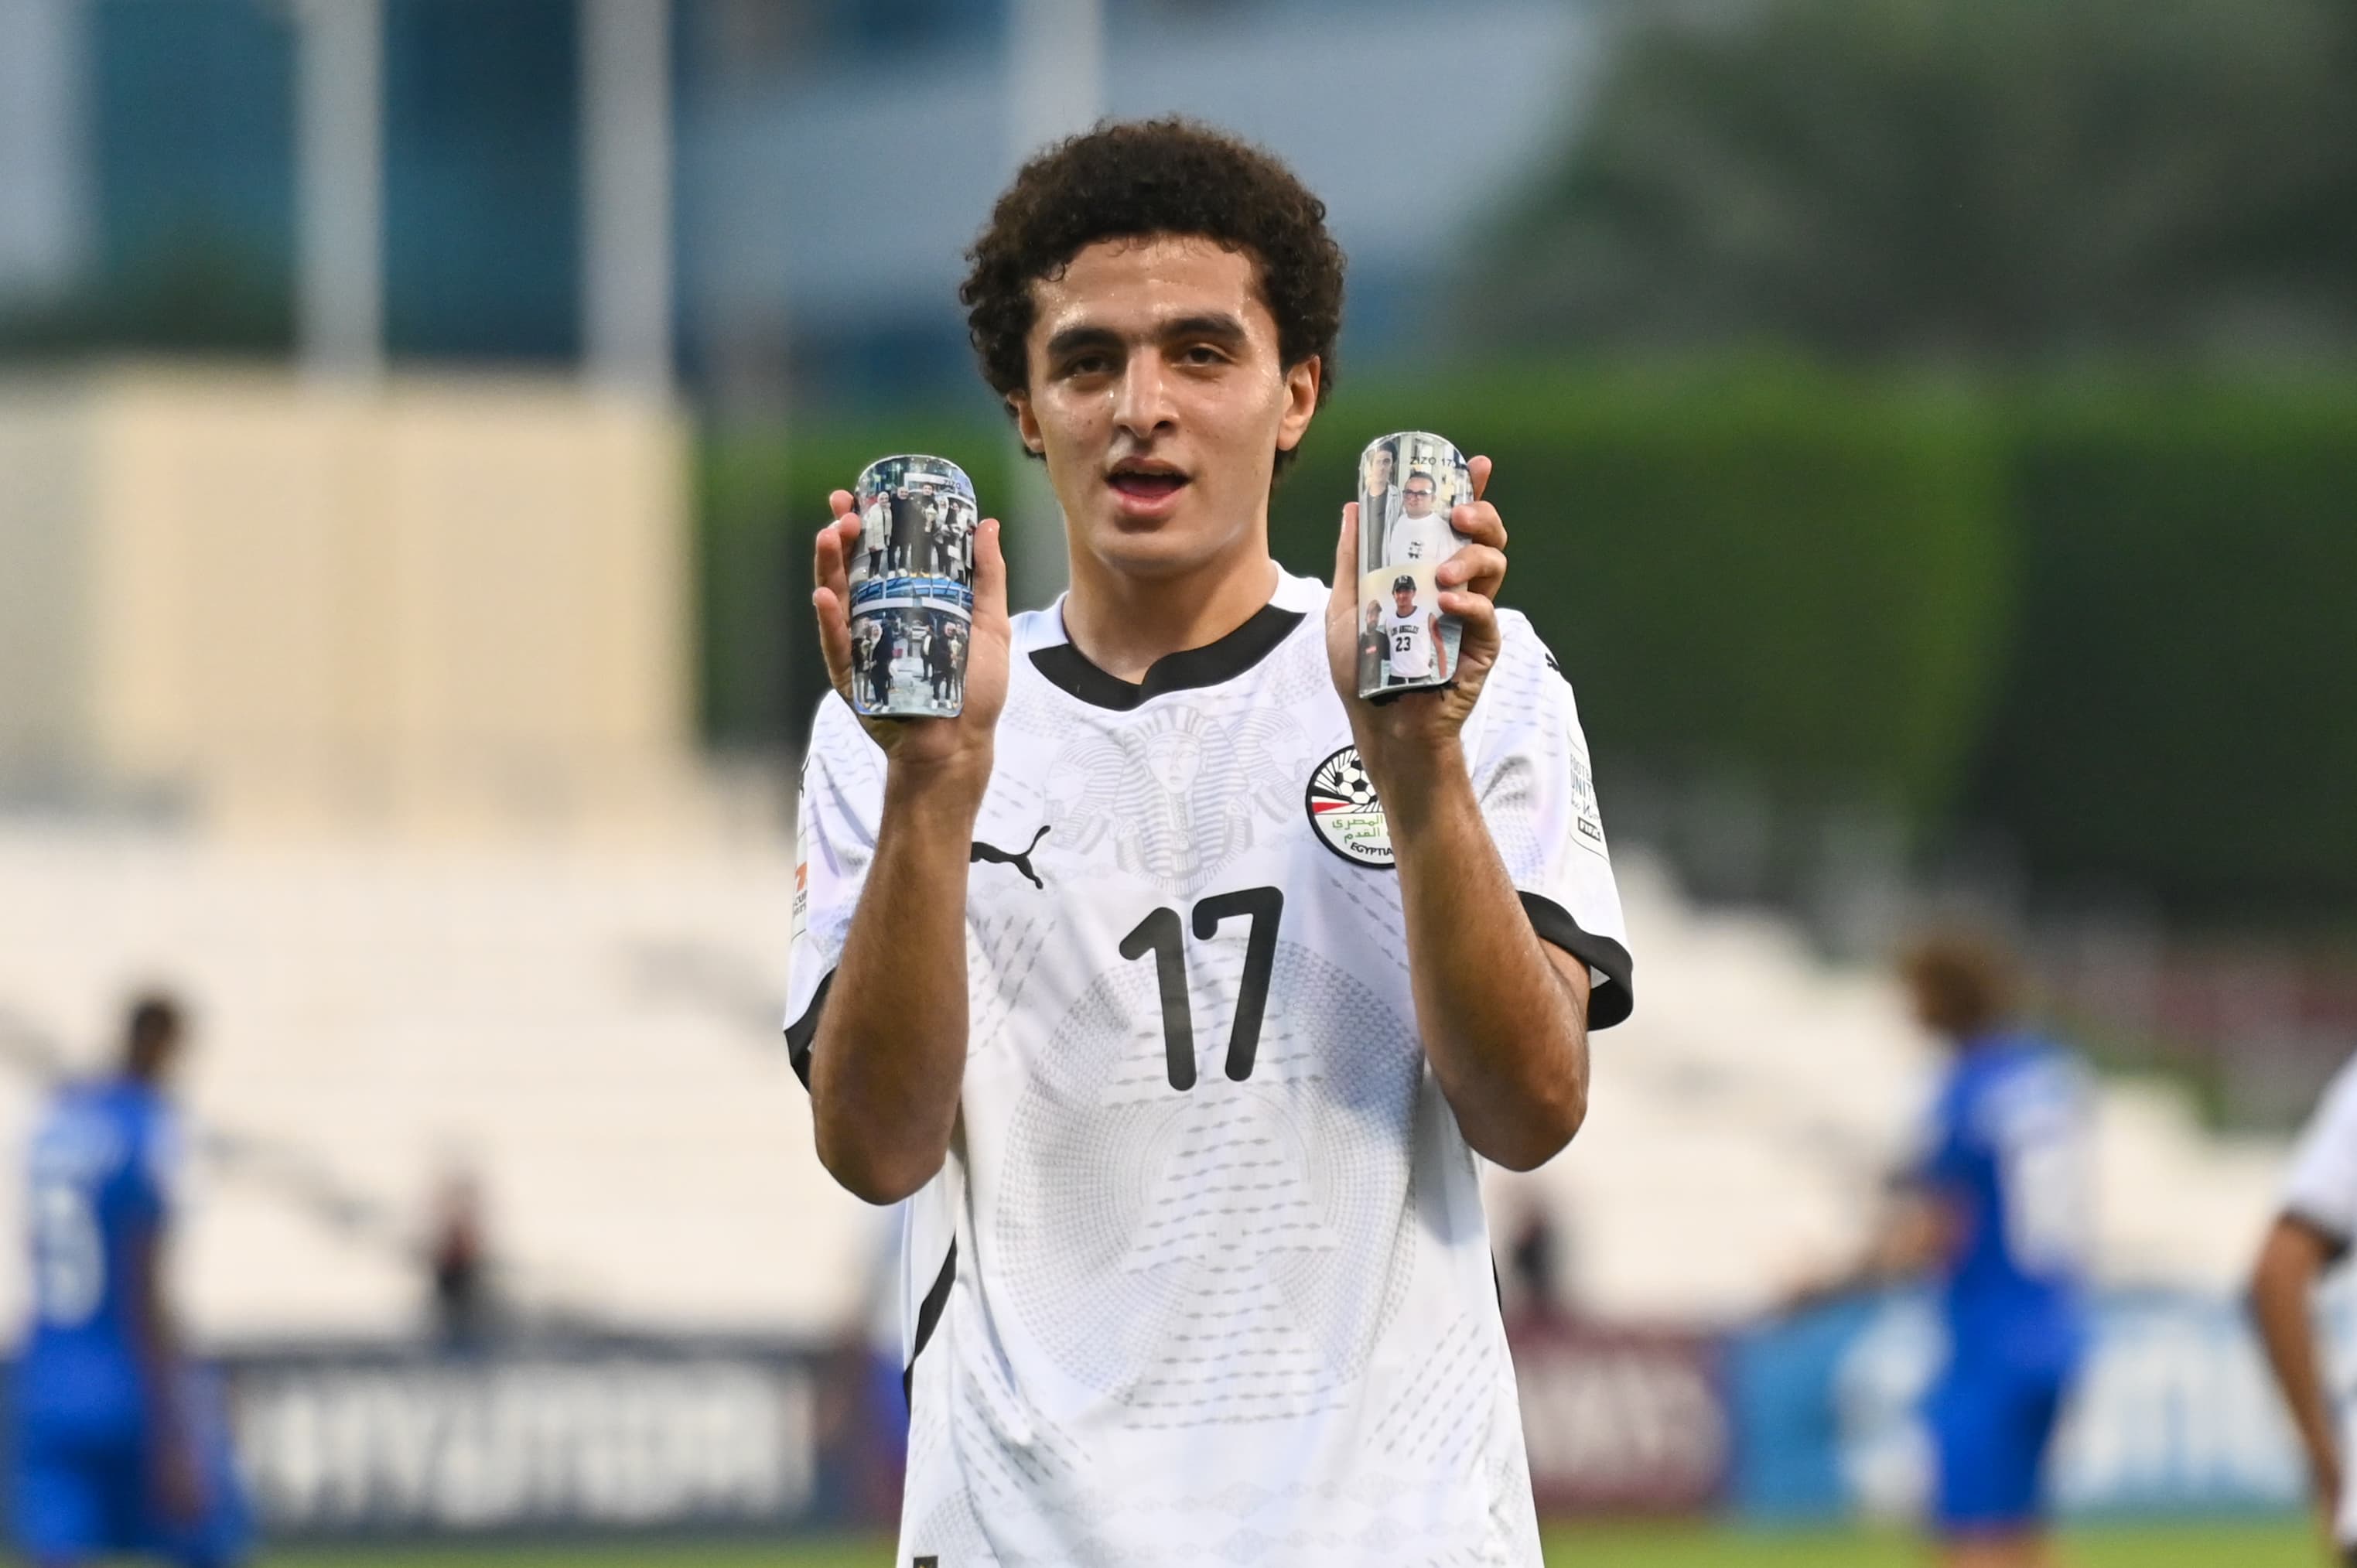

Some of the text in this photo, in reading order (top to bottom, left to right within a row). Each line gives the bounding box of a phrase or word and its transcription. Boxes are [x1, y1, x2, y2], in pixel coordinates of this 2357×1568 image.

[1410, 456, 1453, 467] ZIZO 17
[1395, 636, 1411, 652] 23
[1119, 886, 1284, 1091] 17
